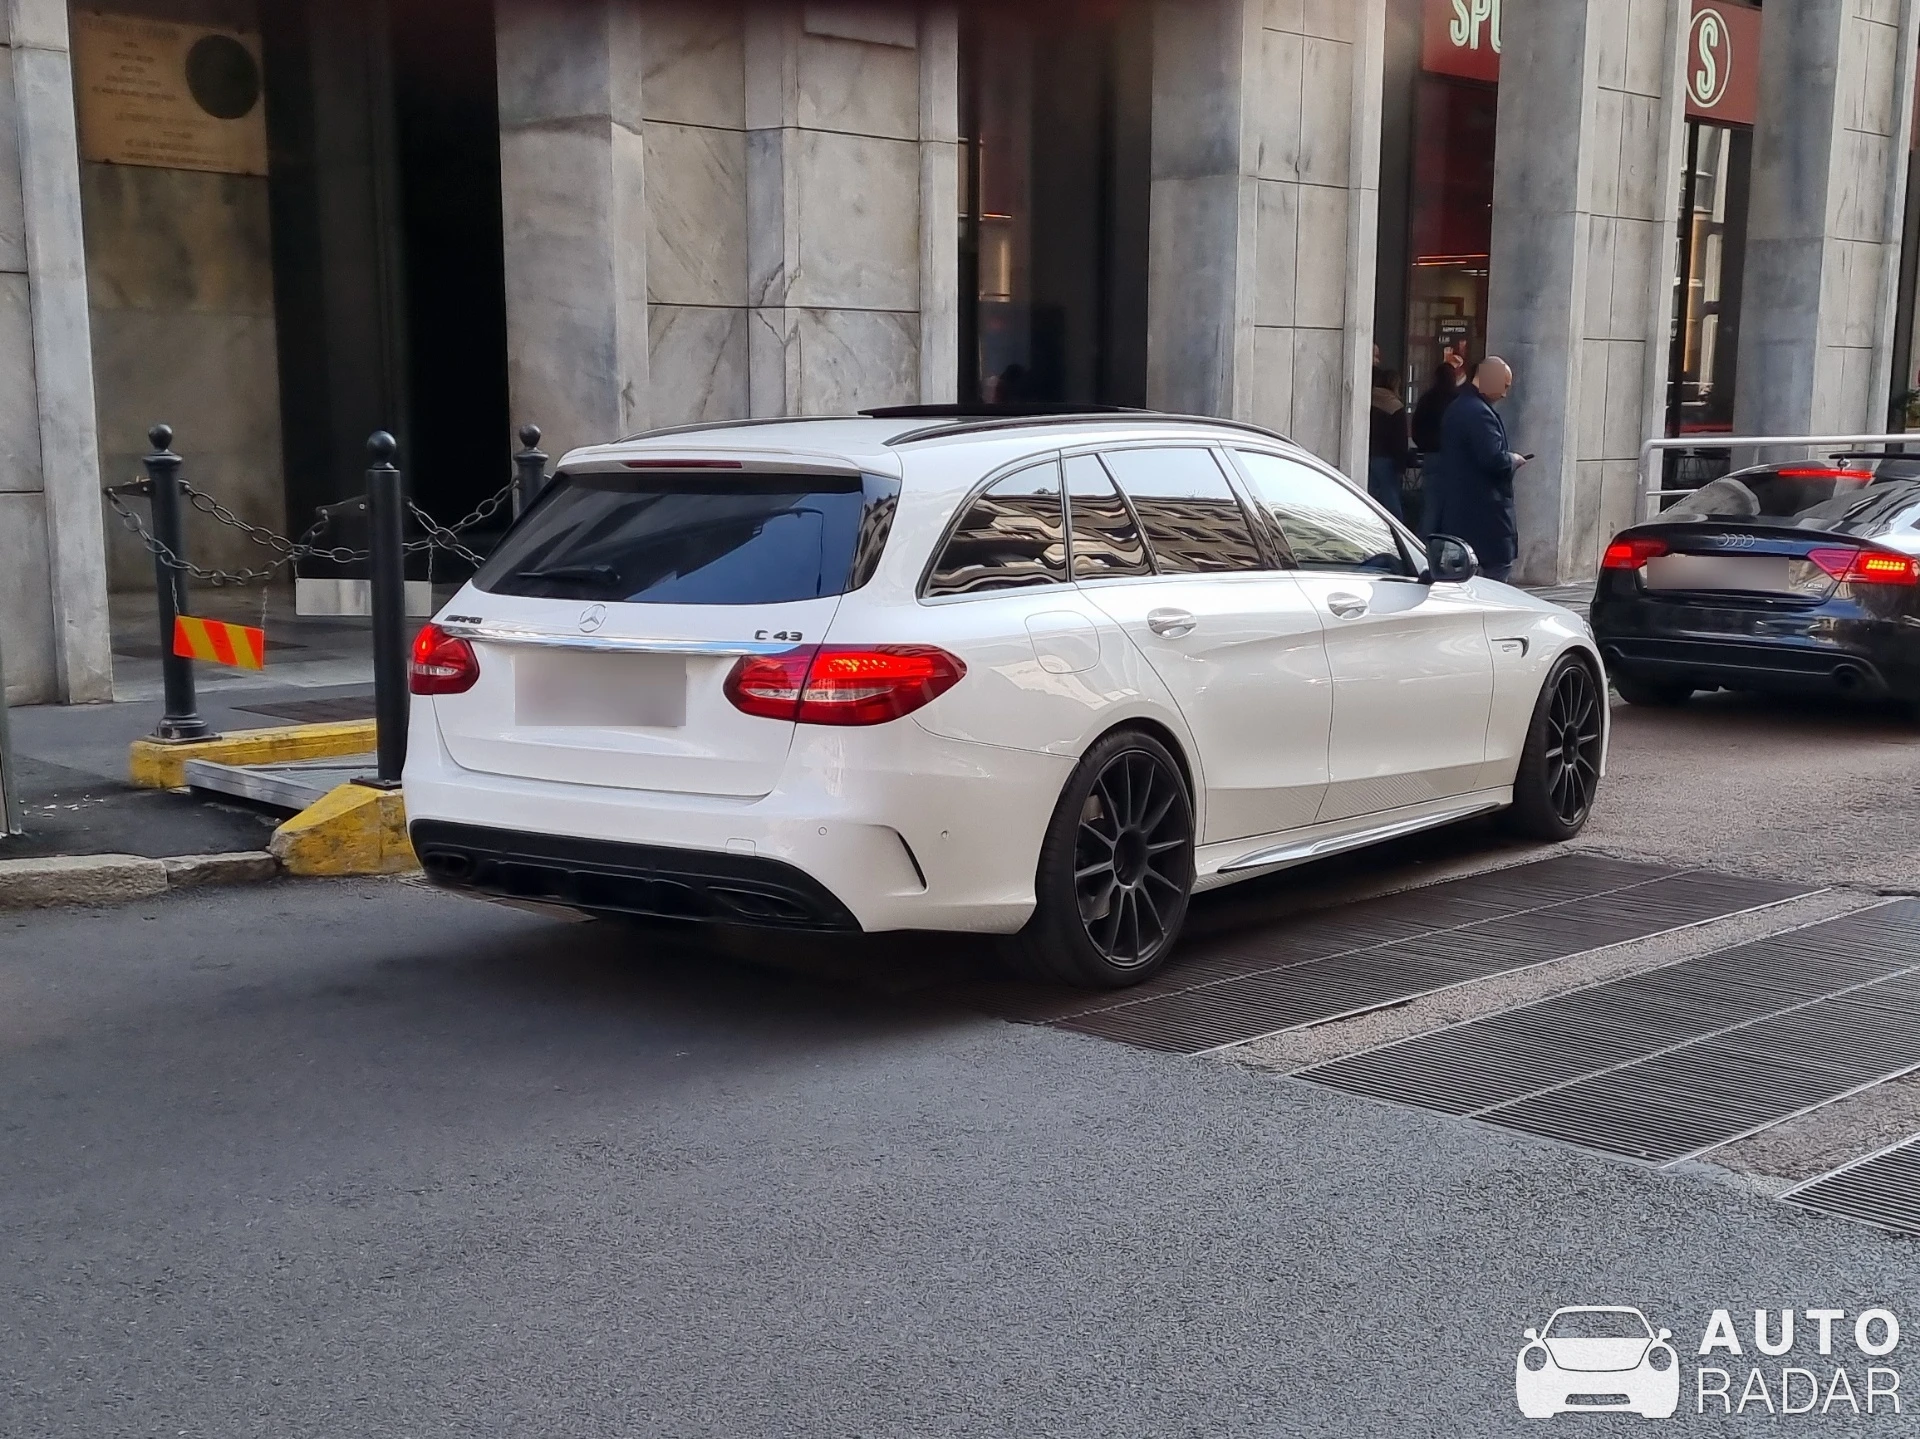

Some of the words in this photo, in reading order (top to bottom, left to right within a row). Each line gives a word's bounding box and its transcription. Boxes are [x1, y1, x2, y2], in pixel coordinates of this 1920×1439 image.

[1696, 17, 1718, 100] S
[754, 629, 769, 641] C
[772, 630, 803, 642] 43
